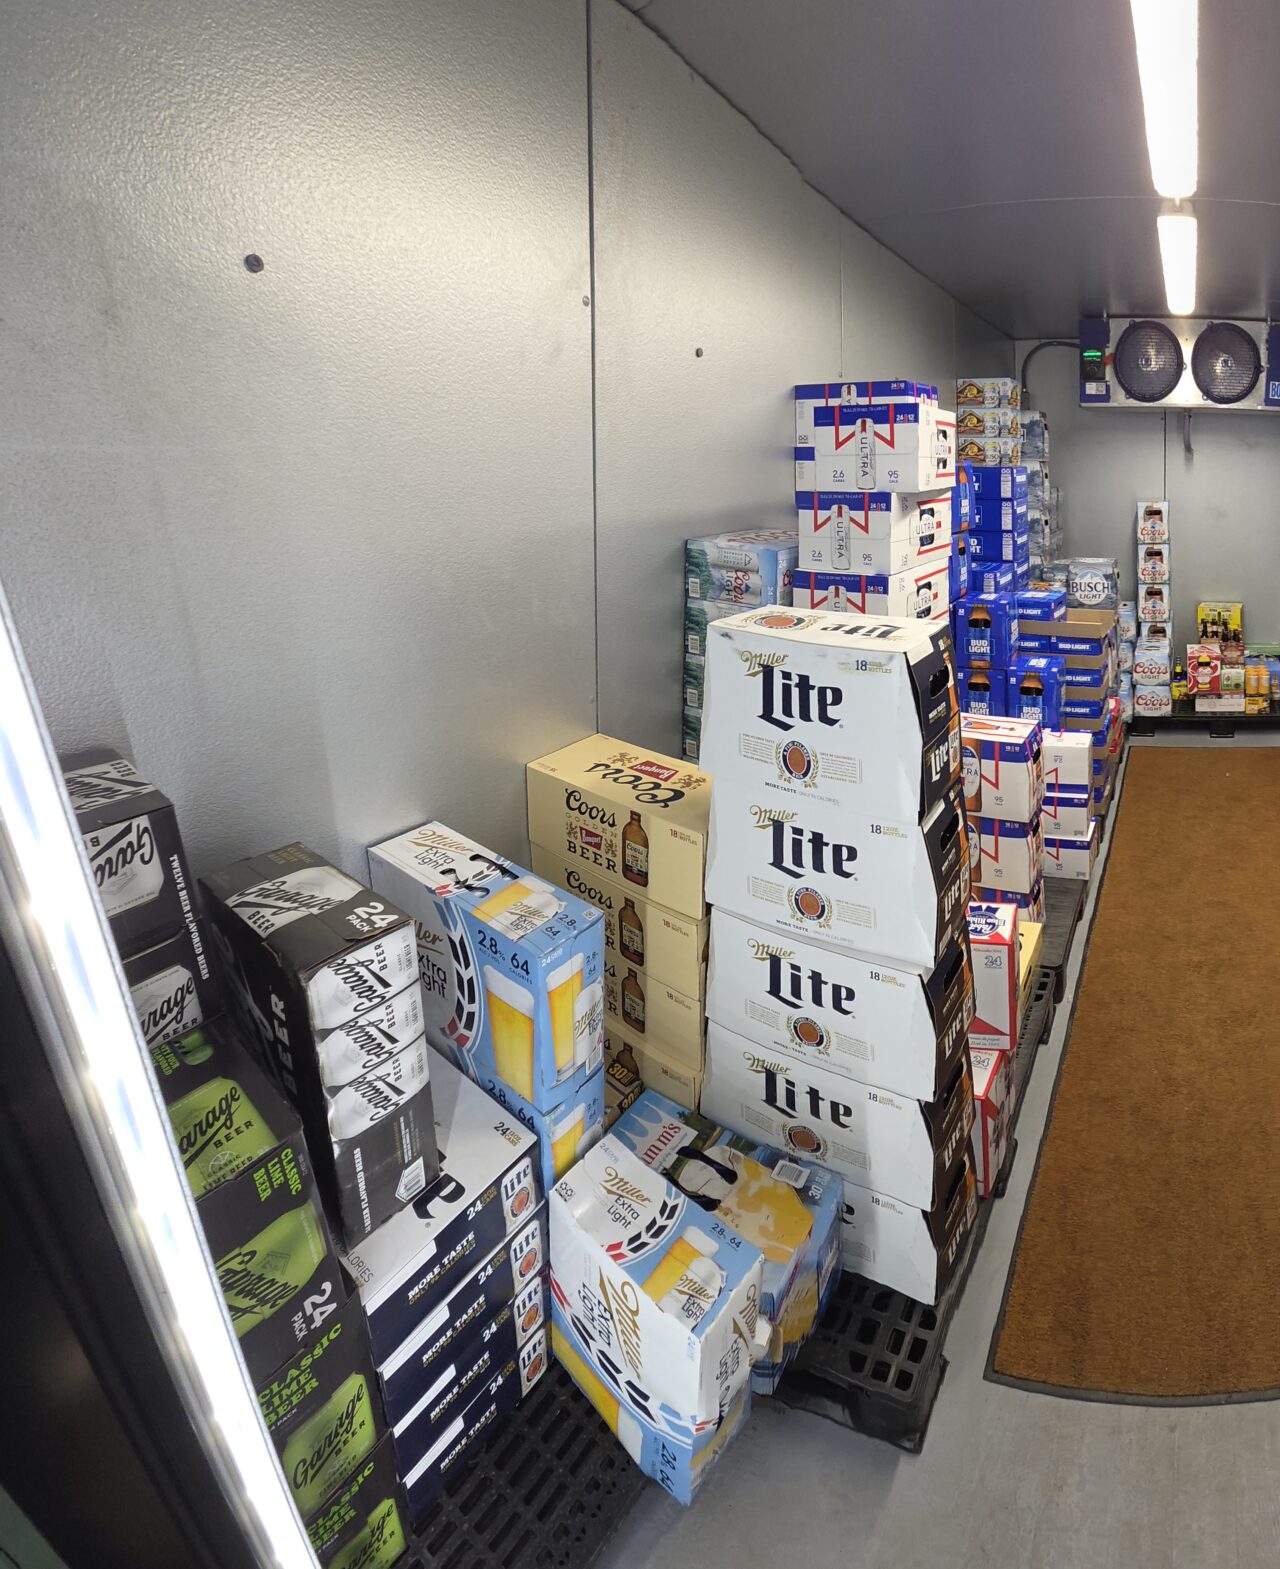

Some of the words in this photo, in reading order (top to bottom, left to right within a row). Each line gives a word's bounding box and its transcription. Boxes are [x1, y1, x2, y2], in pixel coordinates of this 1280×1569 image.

[860, 436, 869, 478] ULTRA
[832, 470, 845, 479] 2.6
[888, 470, 899, 479] 95
[836, 521, 845, 559] ULTRA
[916, 519, 935, 535] ULTRA
[1140, 527, 1166, 537] Coors
[811, 550, 823, 558] 2.6
[862, 554, 873, 562] 95
[1140, 567, 1166, 577] Coors
[1070, 581, 1112, 594] BUSCH
[913, 594, 932, 611] ULTRA
[1140, 606, 1166, 616] Coors
[820, 622, 907, 639] Lite
[740, 650, 789, 672] Miller
[855, 660, 867, 672] 18
[1133, 662, 1168, 675] Coors
[757, 663, 843, 732] Lite
[970, 701, 987, 709] BUD
[1136, 695, 1170, 707] Coors
[633, 763, 677, 780] Banquet
[931, 741, 949, 783] Lite
[584, 762, 685, 809] Coors
[565, 788, 617, 828] Coors
[750, 804, 798, 824] Miller
[565, 812, 618, 839] GOLDEN
[870, 824, 882, 834] 18
[409, 828, 474, 855] Miller
[767, 817, 858, 880] Lite
[413, 853, 445, 870] Light
[424, 846, 456, 864] Extra
[566, 839, 618, 873] BEER
[169, 854, 185, 890] TWELVE
[179, 889, 193, 914] BEER
[233, 879, 345, 917] Garage
[564, 868, 615, 910] Coors
[353, 902, 399, 928] 24
[944, 887, 960, 923] Lite
[184, 913, 204, 956] FLAVORED
[247, 910, 276, 934] BEER
[345, 914, 373, 933] PACK
[544, 925, 560, 937] 64
[374, 942, 388, 972] BEER
[747, 938, 796, 961] Miller
[984, 955, 1002, 967] 24
[197, 955, 211, 981] BEERS
[510, 952, 531, 976] 64
[869, 970, 880, 981] 18
[765, 952, 856, 1016] Lite
[385, 1003, 396, 1029] BEER
[162, 1018, 199, 1041] BEER
[394, 1058, 403, 1082] BEER
[742, 1051, 792, 1073] Miller
[971, 1055, 990, 1068] 24
[760, 1068, 853, 1130] Lite
[868, 1092, 878, 1102] 18
[213, 1120, 254, 1150] BEER
[493, 1122, 510, 1137] 24
[253, 1167, 273, 1202] BEER
[268, 1158, 284, 1189] LIME
[281, 1148, 302, 1196] CLASSIC
[503, 1164, 530, 1199] Lite
[603, 1165, 652, 1204] Miller
[809, 1184, 823, 1199] 30
[870, 1196, 881, 1206] 18
[466, 1199, 483, 1221] 24
[607, 1204, 633, 1230] Light
[614, 1195, 641, 1221] Extra
[511, 1227, 538, 1261] Lite
[729, 1236, 742, 1249] 64
[407, 1264, 442, 1300] MORE
[442, 1232, 475, 1265] TASTE
[477, 1263, 493, 1285] 24
[679, 1274, 716, 1300] Miller
[303, 1281, 337, 1330] 24
[291, 1311, 309, 1342] PACK
[422, 1330, 453, 1363] MORE
[453, 1294, 486, 1331] TASTE
[257, 1323, 342, 1403] CLASSIC
[520, 1334, 546, 1371] Lite
[430, 1384, 459, 1420] MORE
[459, 1350, 491, 1387] TASTE
[293, 1383, 365, 1490] Garage
[334, 1419, 366, 1458] BEER
[439, 1438, 468, 1472] MORE
[468, 1402, 497, 1440] TASTE
